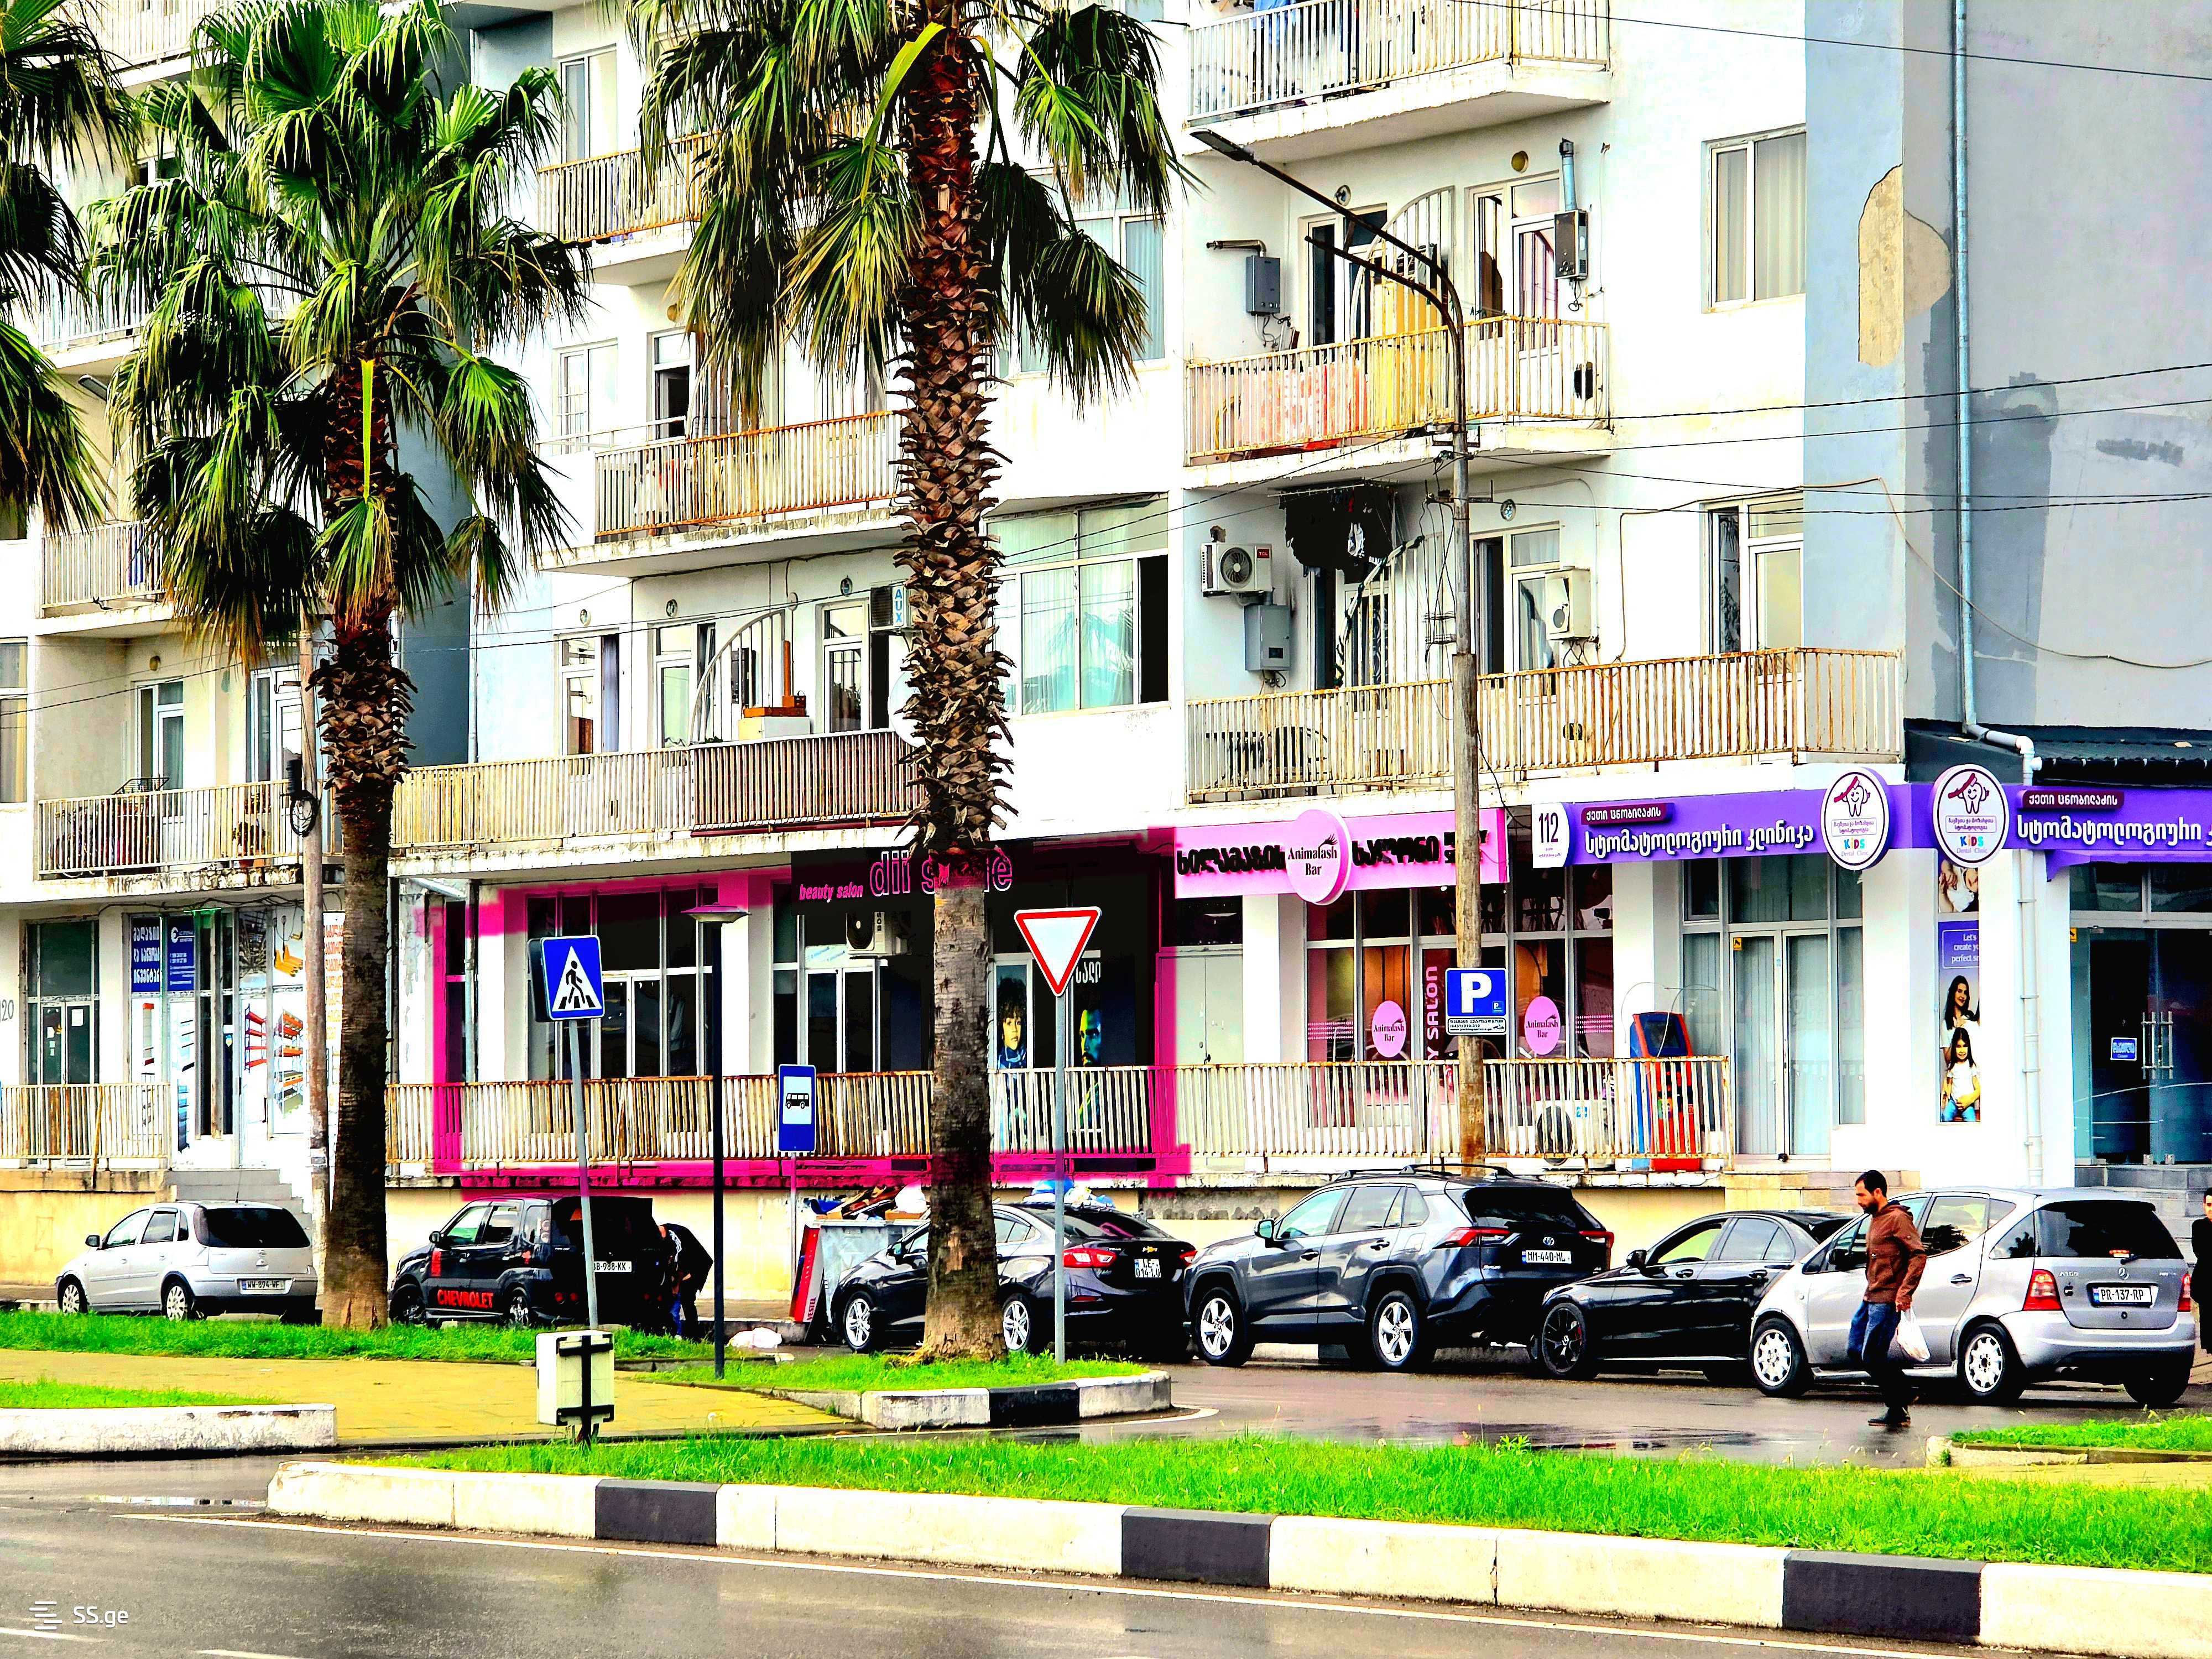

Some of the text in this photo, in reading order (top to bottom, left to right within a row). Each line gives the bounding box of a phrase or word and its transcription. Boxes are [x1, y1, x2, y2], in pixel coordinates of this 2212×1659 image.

[2029, 794, 2055, 805] ქეთი
[1586, 810, 1608, 821] ქეთი
[1538, 812, 1558, 843] 112
[2017, 814, 2201, 846] სტომატოლოგიური
[1585, 819, 1814, 859] სტომატოლოგიური კლინიკა
[1287, 846, 1338, 860] Animalash
[1305, 863, 1322, 875] Bar
[799, 882, 863, 903] beauty salon
[1951, 954, 1972, 964] perfect
[1460, 973, 1492, 1013] P
[1374, 1024, 1405, 1032] Animalash
[1526, 1019, 1558, 1029] Animalash
[1537, 1030, 1548, 1038] Bar
[437, 1289, 494, 1308] CHEVROLET
[2100, 1288, 2144, 1301] PR-137-RP
